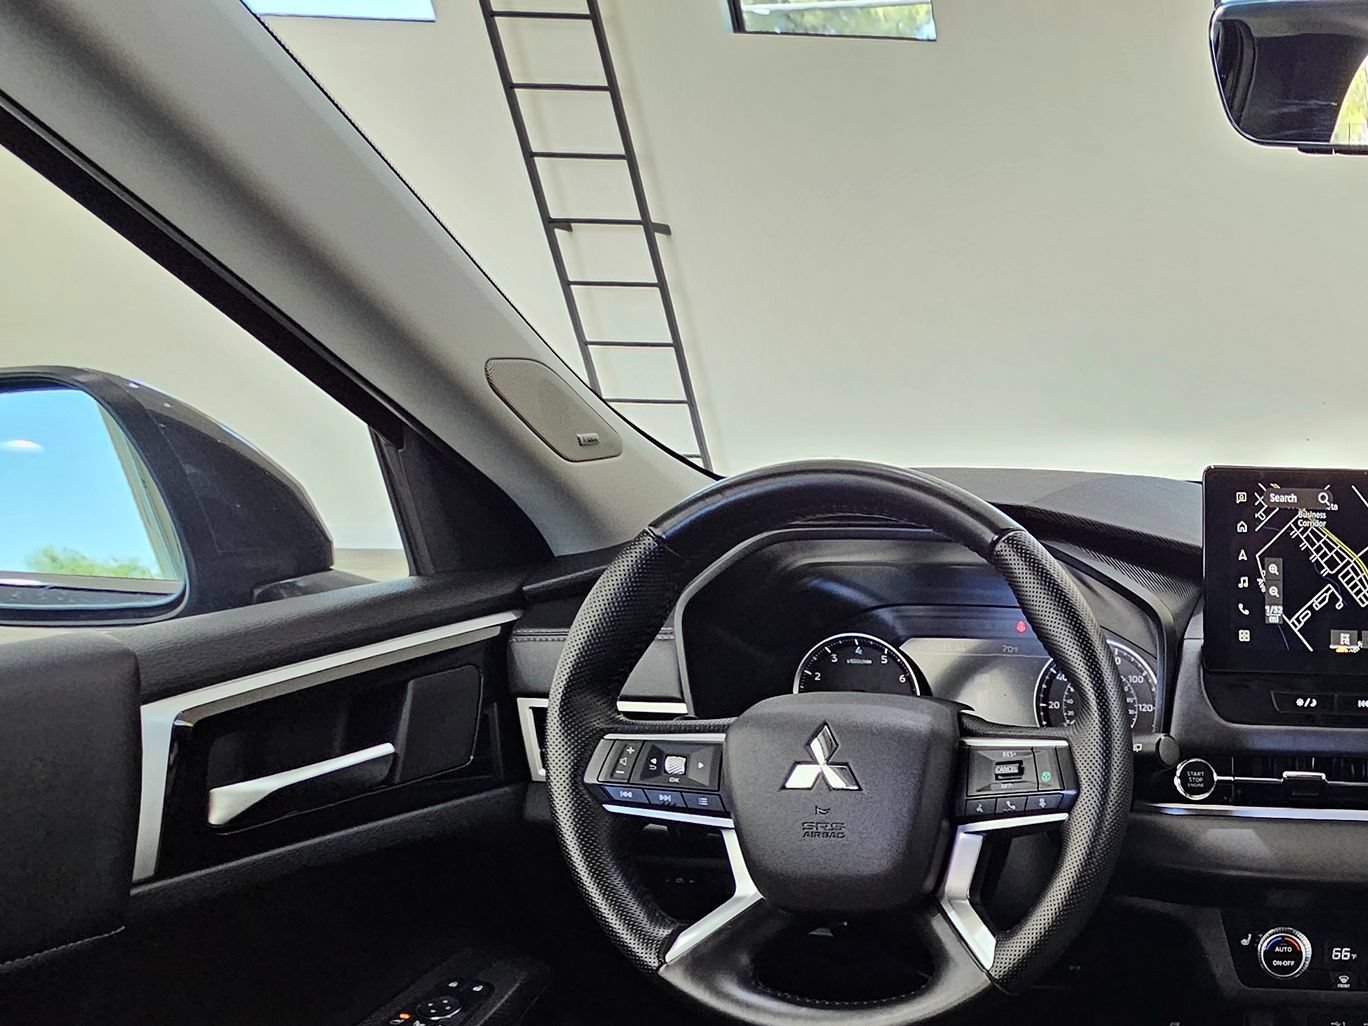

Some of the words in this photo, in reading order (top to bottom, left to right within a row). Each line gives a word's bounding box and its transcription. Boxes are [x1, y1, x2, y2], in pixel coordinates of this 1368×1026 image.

[1269, 493, 1298, 503] Search
[1298, 511, 1327, 519] Business
[1298, 519, 1327, 527] Corridor
[855, 646, 863, 655] 4
[831, 654, 838, 662] 3
[881, 655, 888, 664] 5
[814, 672, 821, 681] 2
[899, 674, 906, 683] 6
[1128, 675, 1144, 684] 100
[1048, 701, 1060, 709] 20
[1138, 703, 1153, 712] 120
[995, 765, 1018, 773] CANCEL
[801, 821, 846, 831] SRS
[802, 831, 846, 839] AIRBAG
